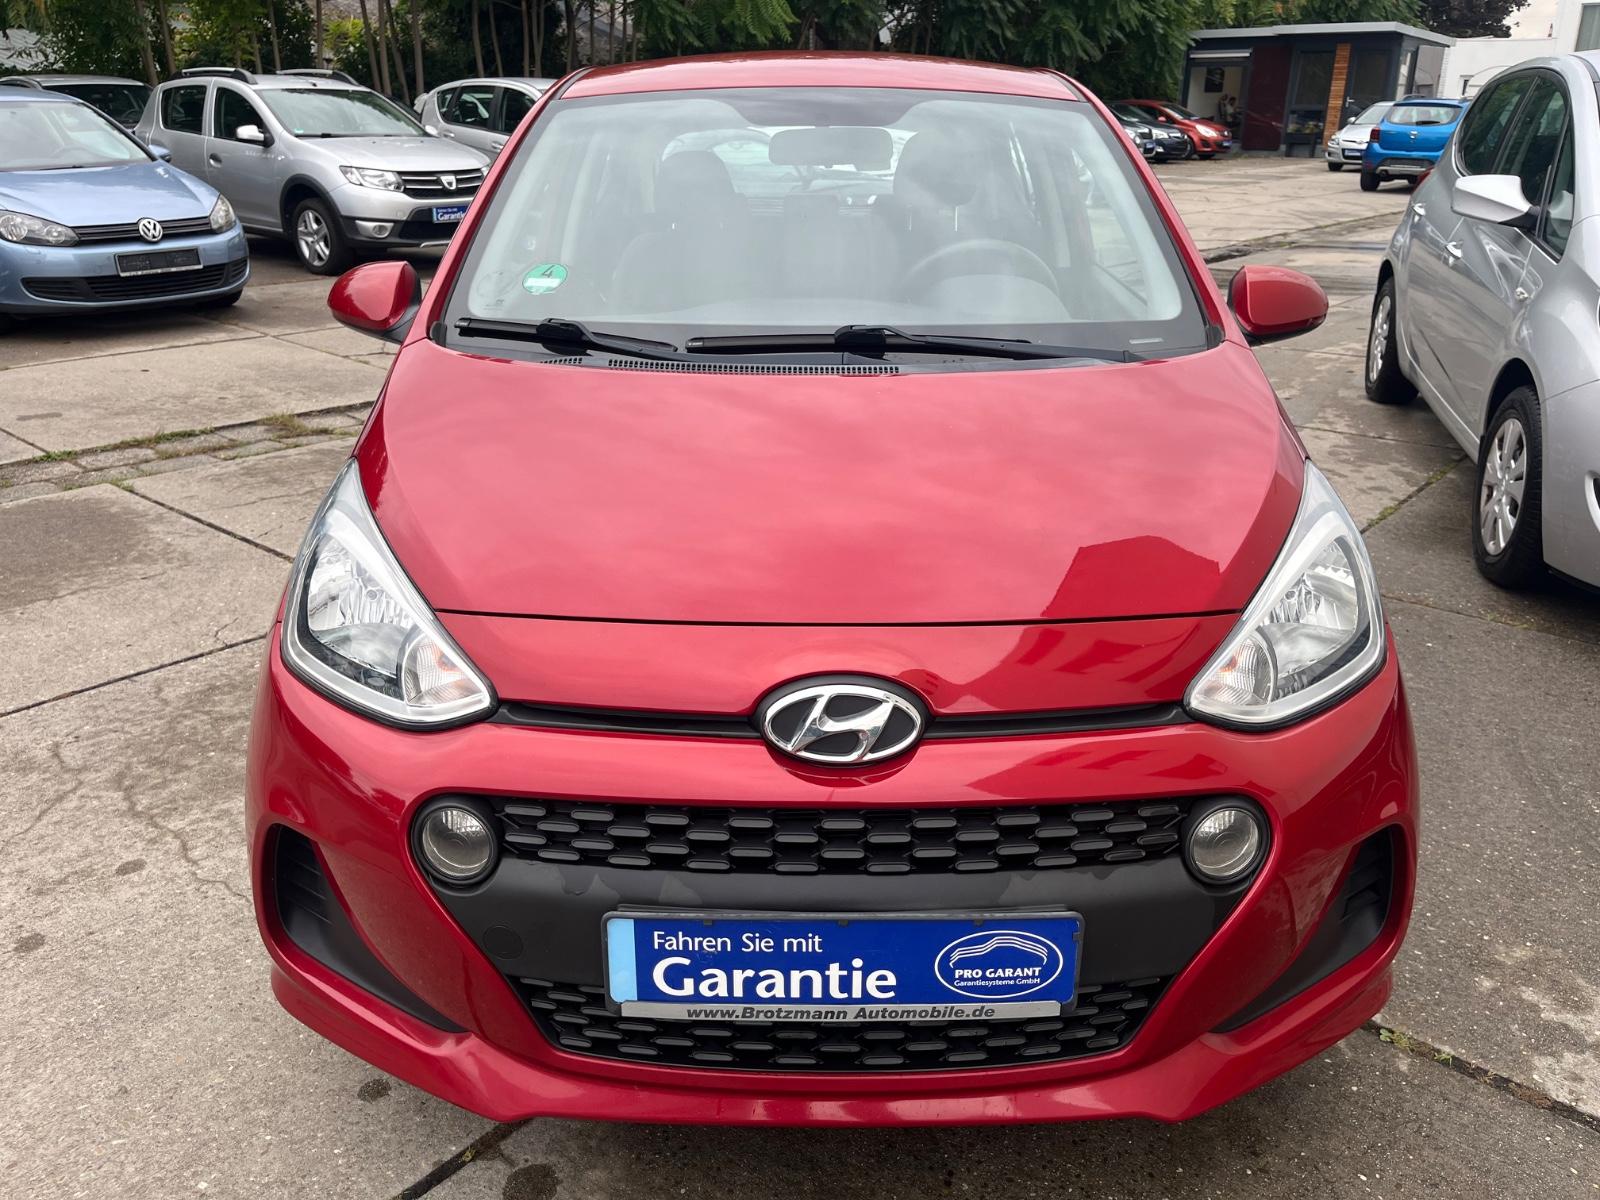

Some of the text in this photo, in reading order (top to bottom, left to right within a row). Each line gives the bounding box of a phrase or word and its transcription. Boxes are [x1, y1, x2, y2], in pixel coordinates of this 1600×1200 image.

[542, 264, 556, 278] 4
[653, 931, 823, 952] Fahren Sie mit
[652, 956, 897, 999] Garantie
[954, 967, 1042, 979] PRO GARANT
[954, 977, 1041, 988] Garantiesysteme GmbH
[687, 1005, 996, 1020] www.Brotzmann Automobile.de
